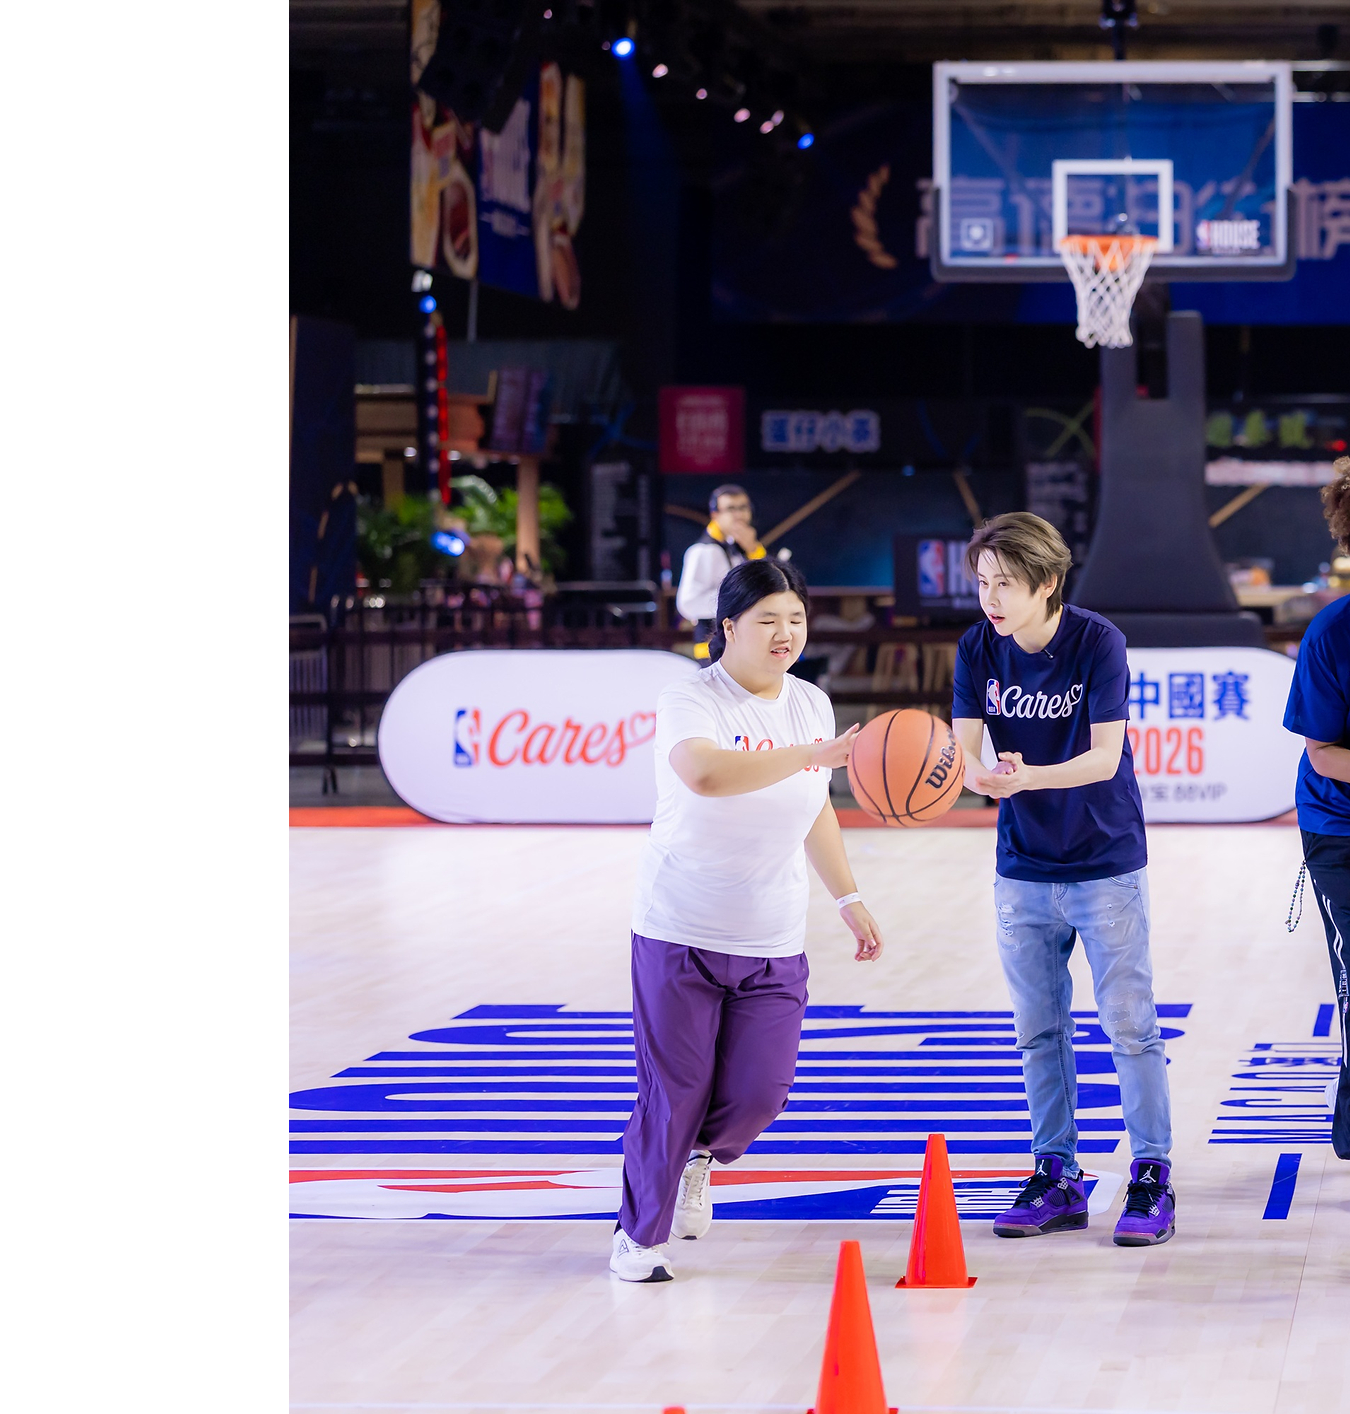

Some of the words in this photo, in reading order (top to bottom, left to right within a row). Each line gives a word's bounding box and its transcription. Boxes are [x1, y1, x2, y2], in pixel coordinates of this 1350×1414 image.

[1000, 685, 1073, 719] Cares
[1128, 671, 1250, 721] 中國賽
[488, 708, 628, 768] Cares
[1126, 726, 1204, 775] 2026
